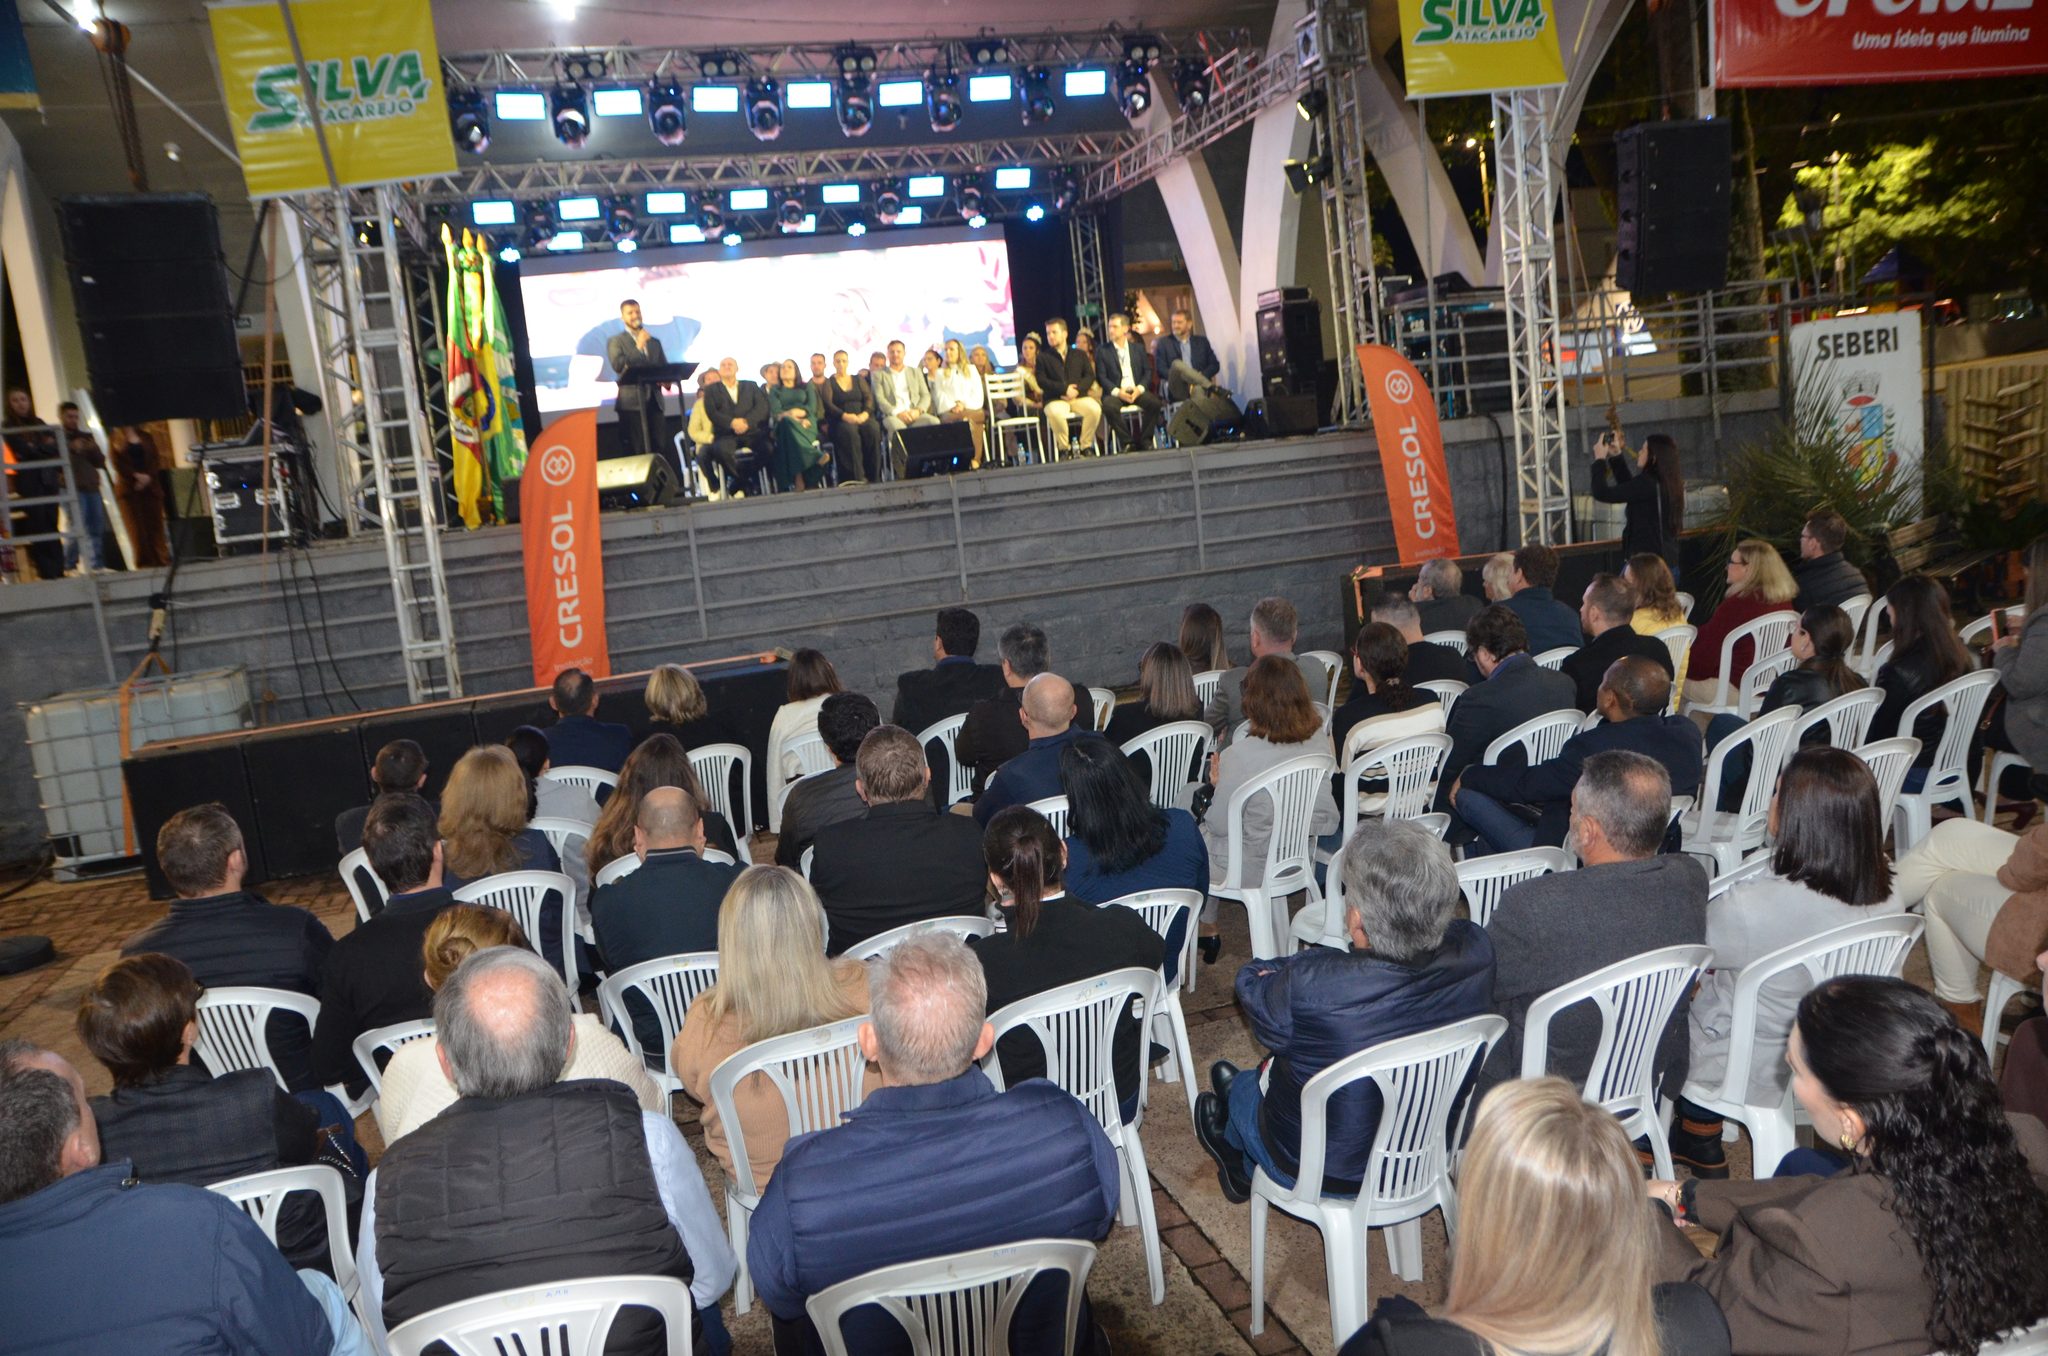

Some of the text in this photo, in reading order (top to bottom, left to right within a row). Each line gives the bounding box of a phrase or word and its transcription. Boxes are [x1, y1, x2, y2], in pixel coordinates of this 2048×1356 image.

[1413, 0, 1546, 44] SILVA
[1454, 26, 1535, 42] ATACAREJO
[1852, 23, 2031, 50] Uma ideia que ilumina
[1816, 326, 1899, 361] SEBERI
[1399, 415, 1436, 540] CRESOL
[550, 499, 584, 649] CRESOL
